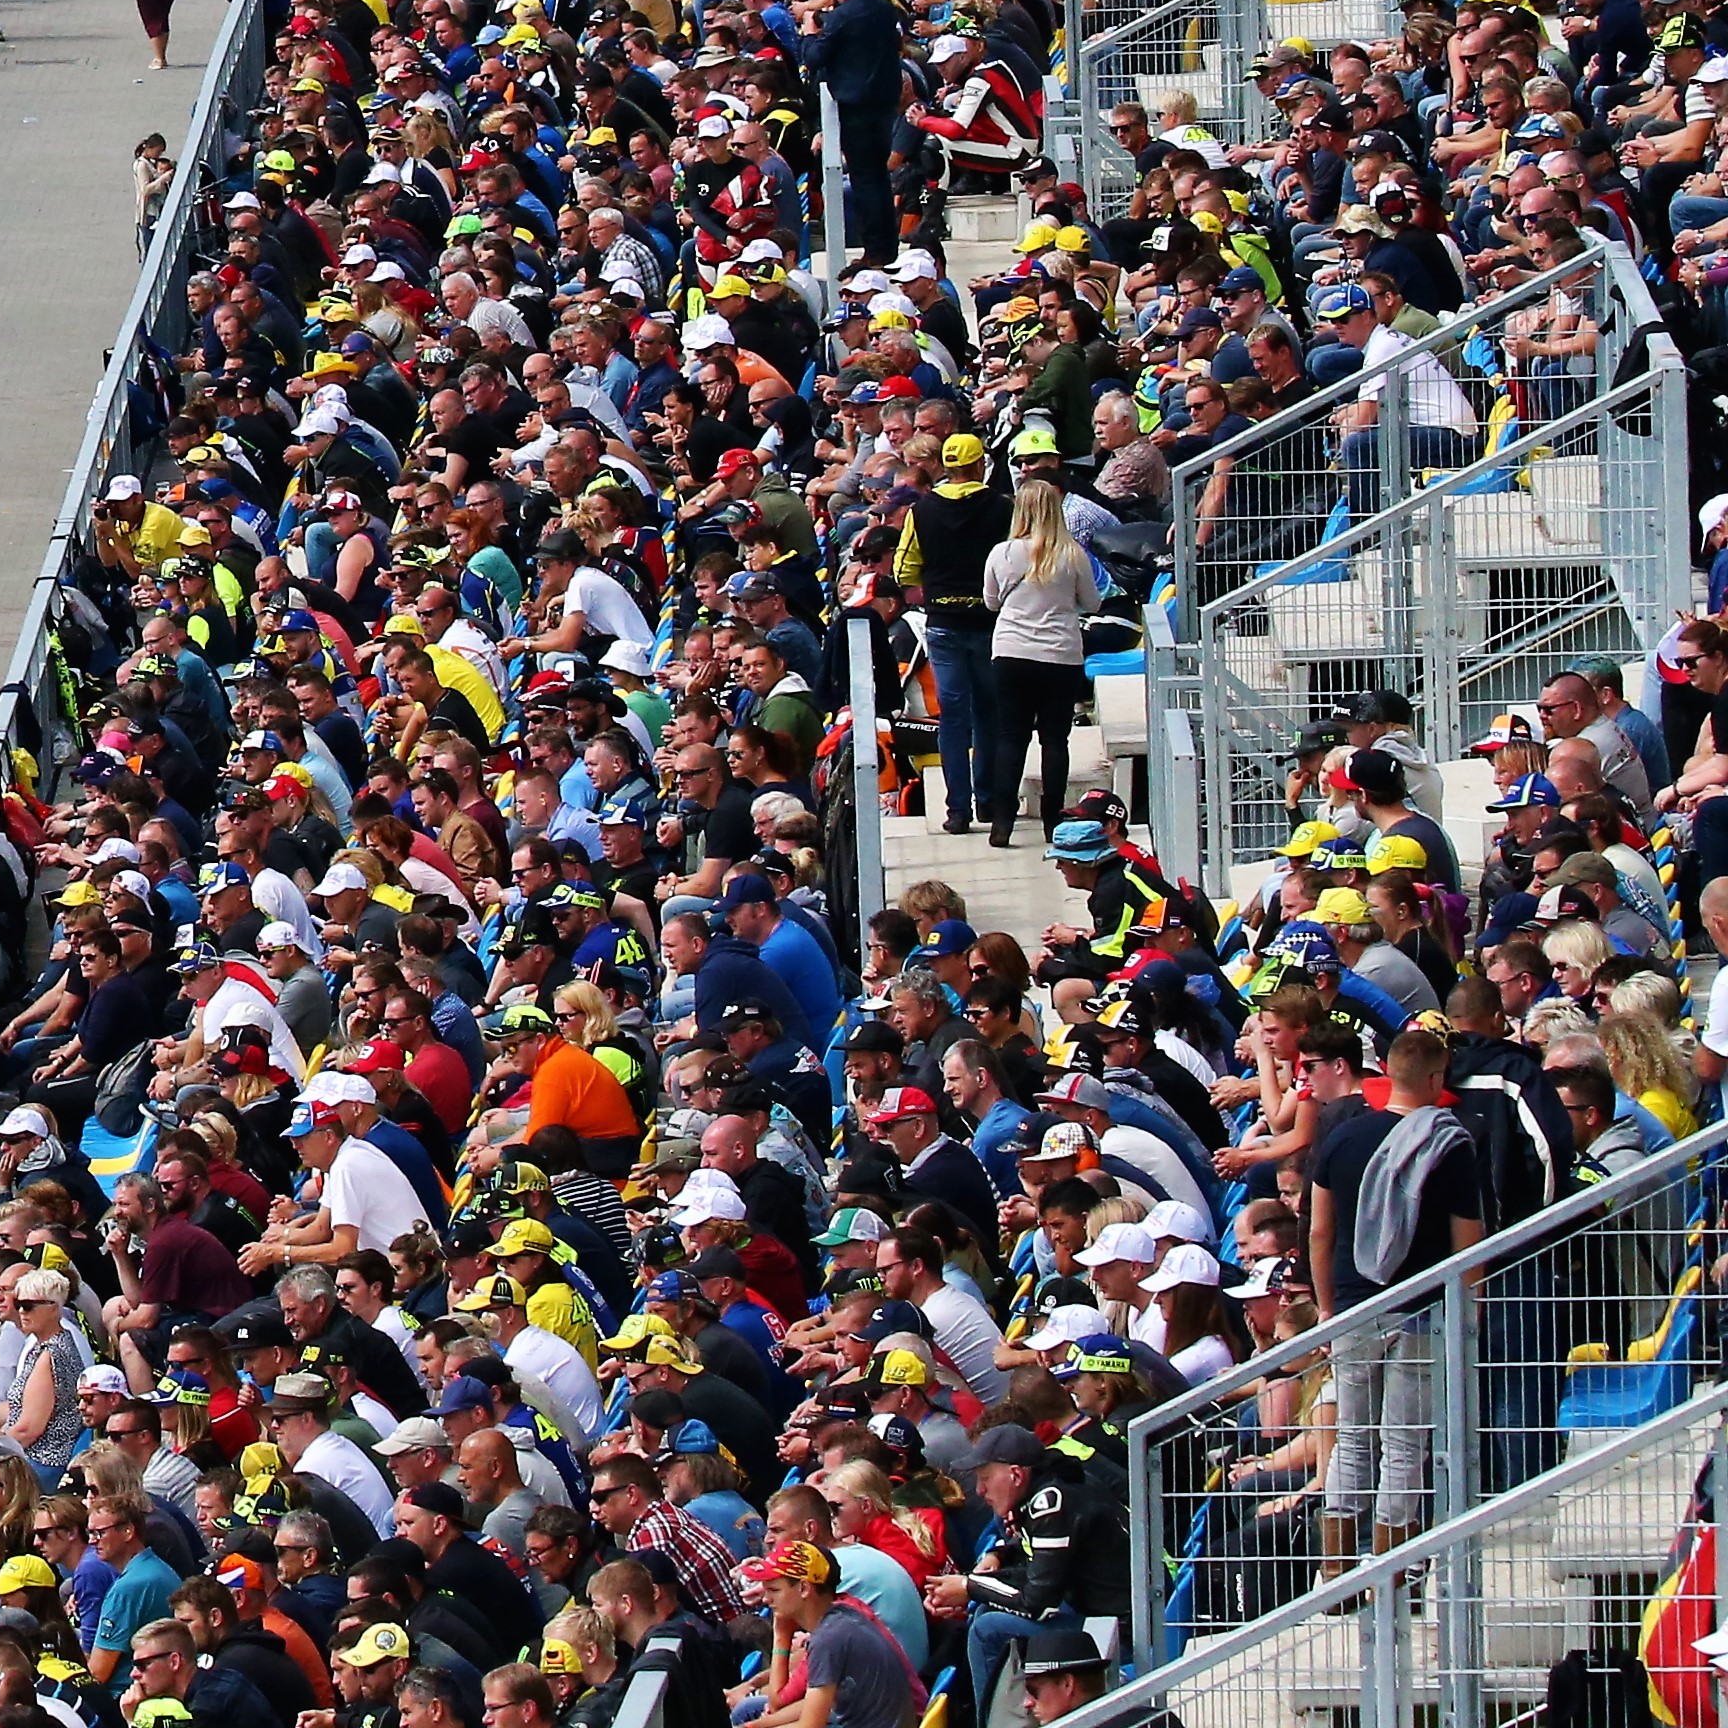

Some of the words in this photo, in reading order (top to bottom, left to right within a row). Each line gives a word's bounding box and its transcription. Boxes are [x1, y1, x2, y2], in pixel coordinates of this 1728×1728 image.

[1106, 803, 1124, 817] 93
[615, 935, 646, 965] 46
[1096, 1360, 1127, 1369] YAMAHA
